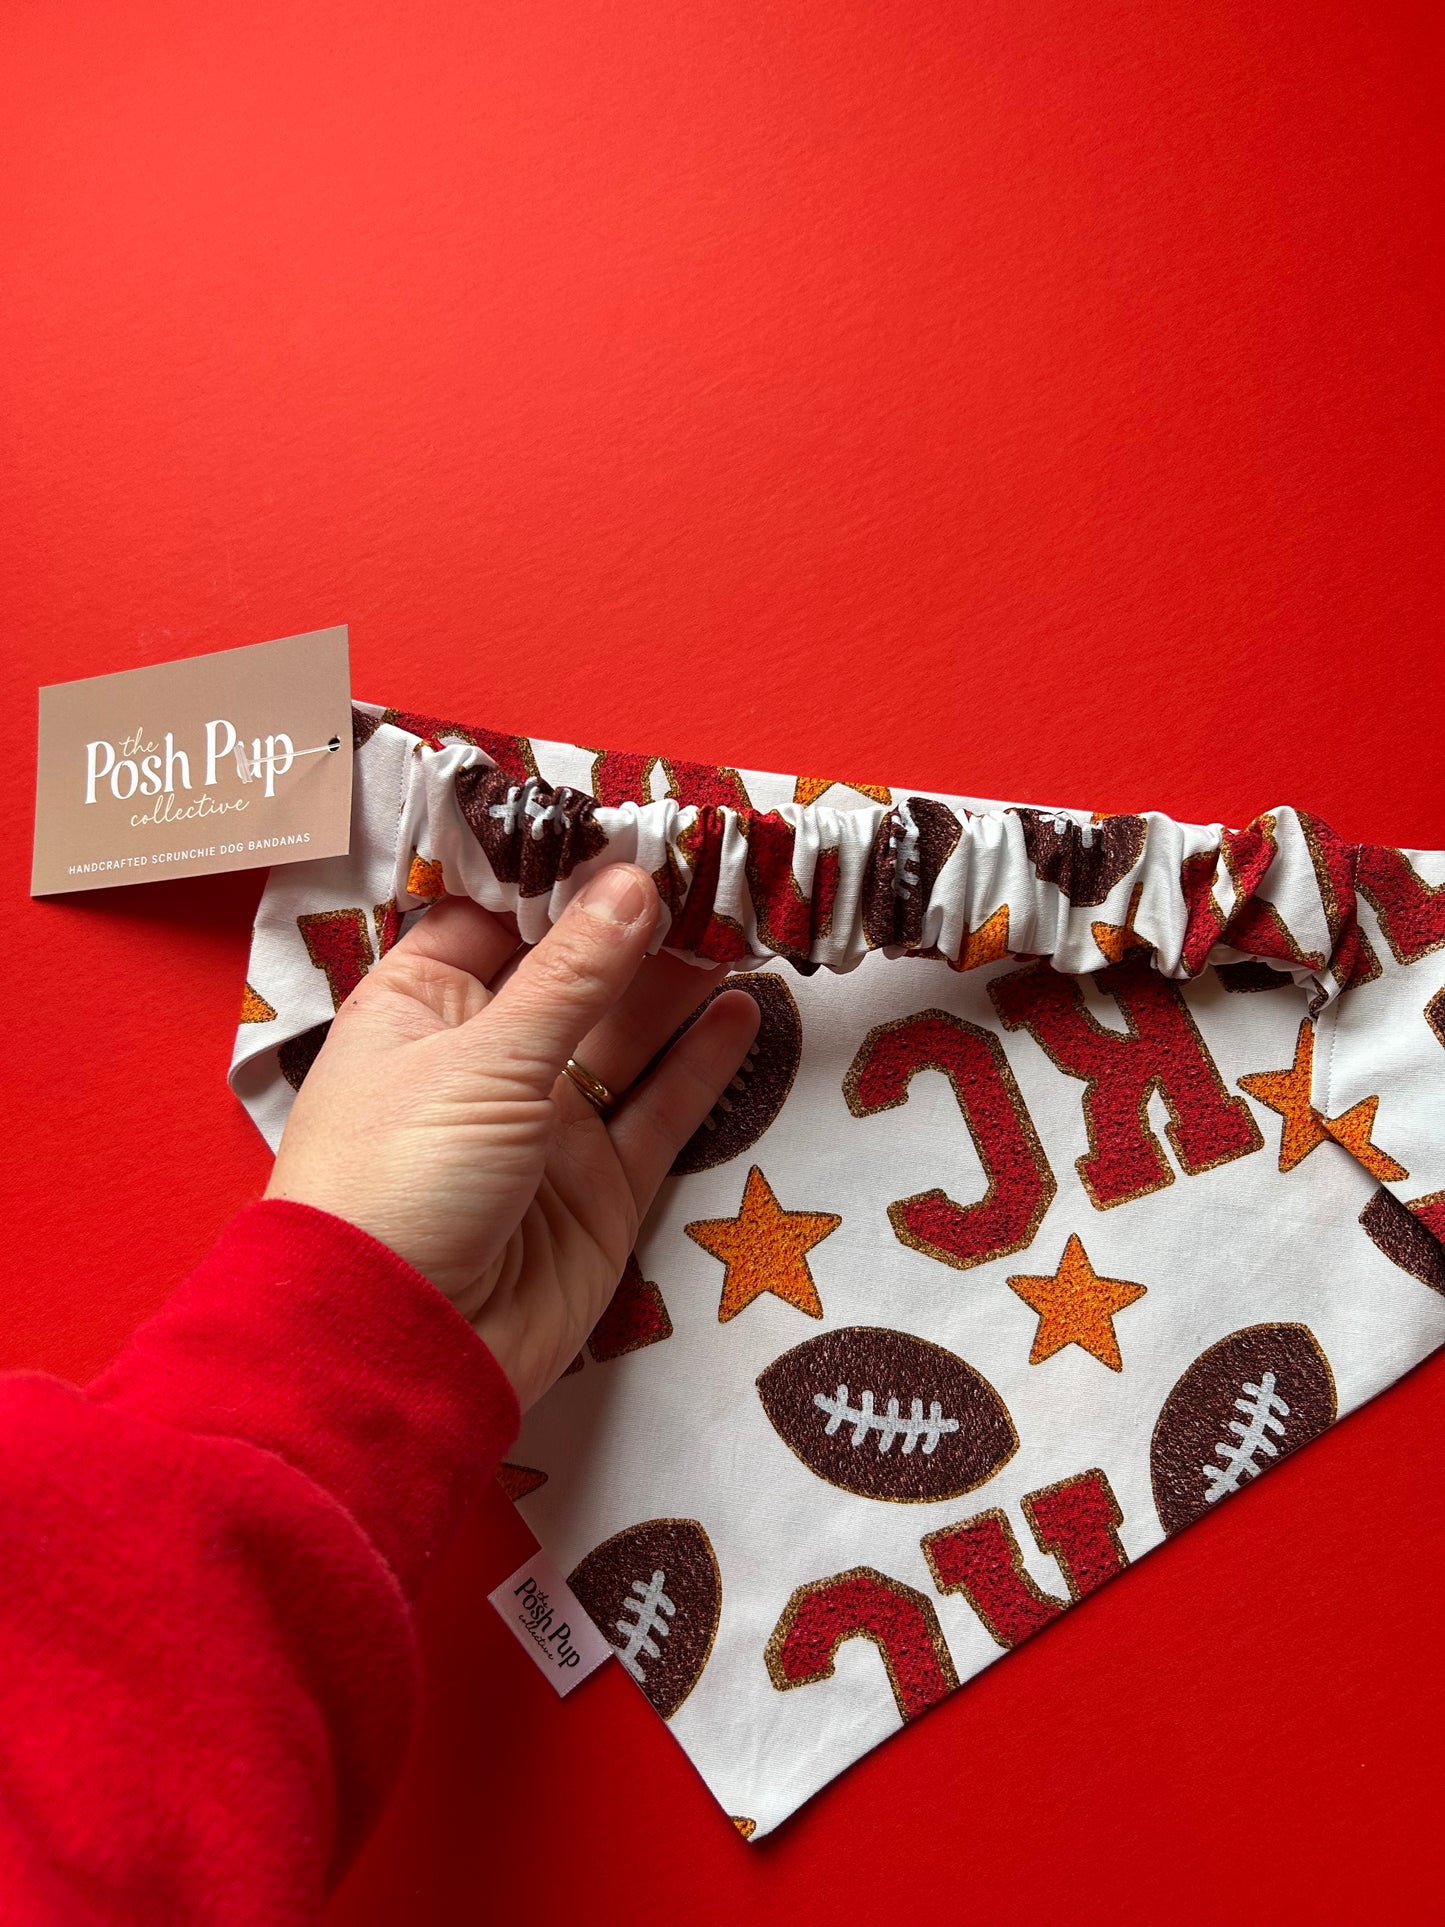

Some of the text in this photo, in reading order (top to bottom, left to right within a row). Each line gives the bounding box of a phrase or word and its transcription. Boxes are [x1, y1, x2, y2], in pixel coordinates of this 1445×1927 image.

[84, 732, 193, 805] Posh
[204, 719, 294, 798] Pup
[118, 726, 160, 757] the
[130, 792, 250, 827] collective
[68, 832, 311, 875] HANDCRAFTED SCRUNCHIE DOG BANDANAS
[513, 1576, 581, 1669] Posh Pup
[518, 1614, 554, 1661] collective
